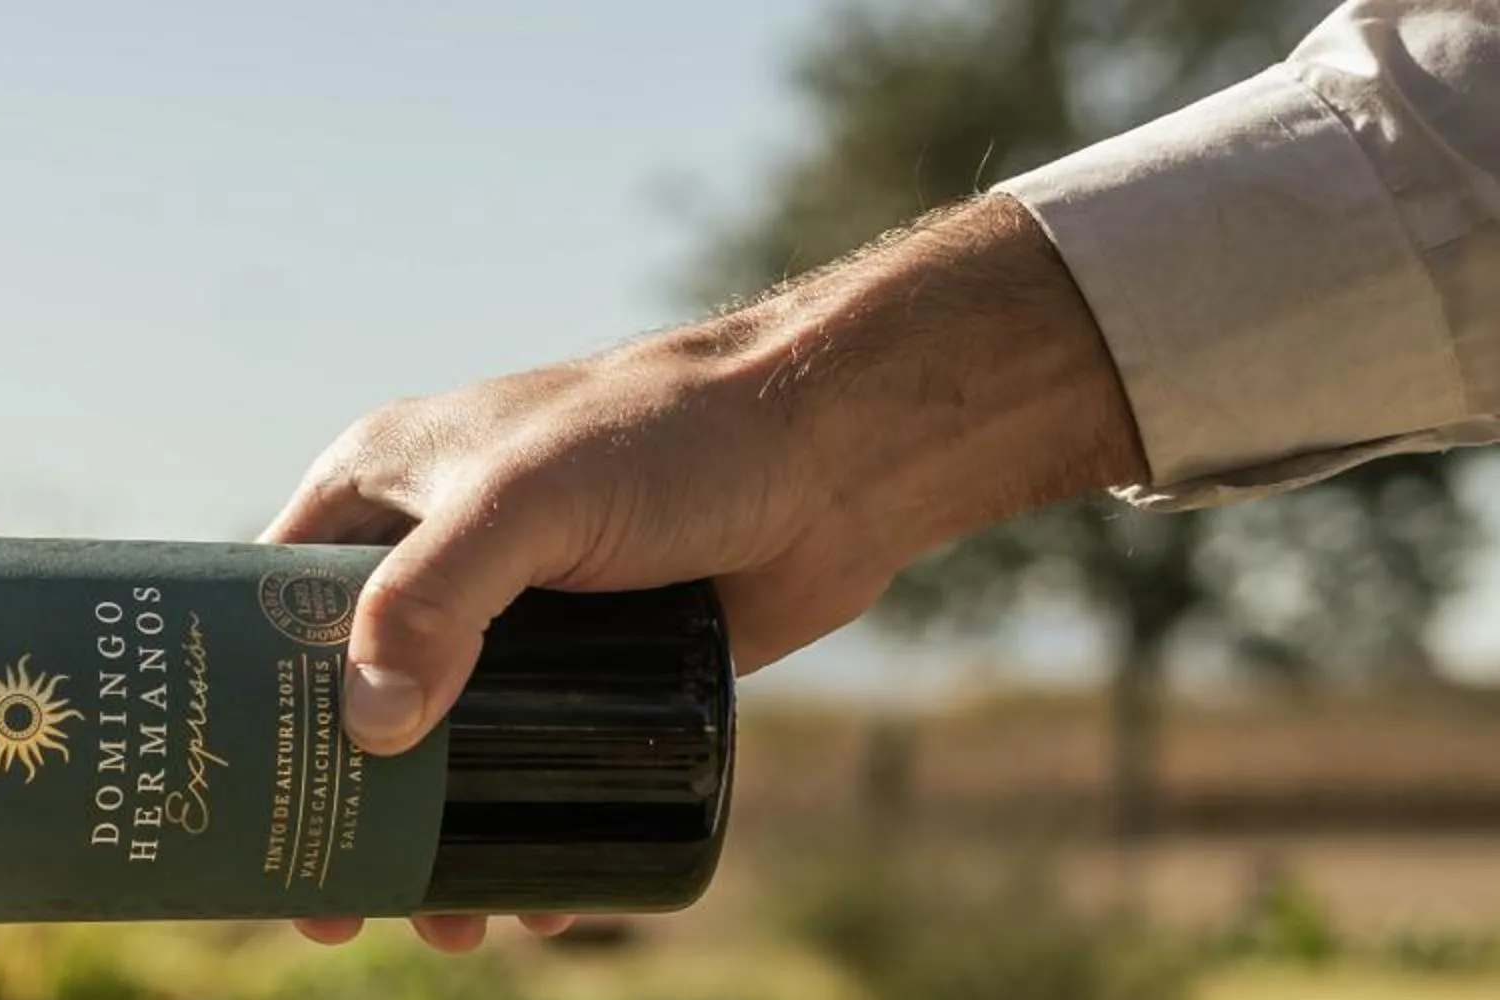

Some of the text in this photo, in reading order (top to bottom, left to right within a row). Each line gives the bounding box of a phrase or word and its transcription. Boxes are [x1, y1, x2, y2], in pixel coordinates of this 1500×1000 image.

[91, 601, 128, 846] DOMINGO
[129, 586, 168, 863] HERMANOS
[164, 609, 229, 835] Expresión
[264, 659, 296, 873] TINTO DE ALTURA 2022
[300, 815, 325, 878] VALLES
